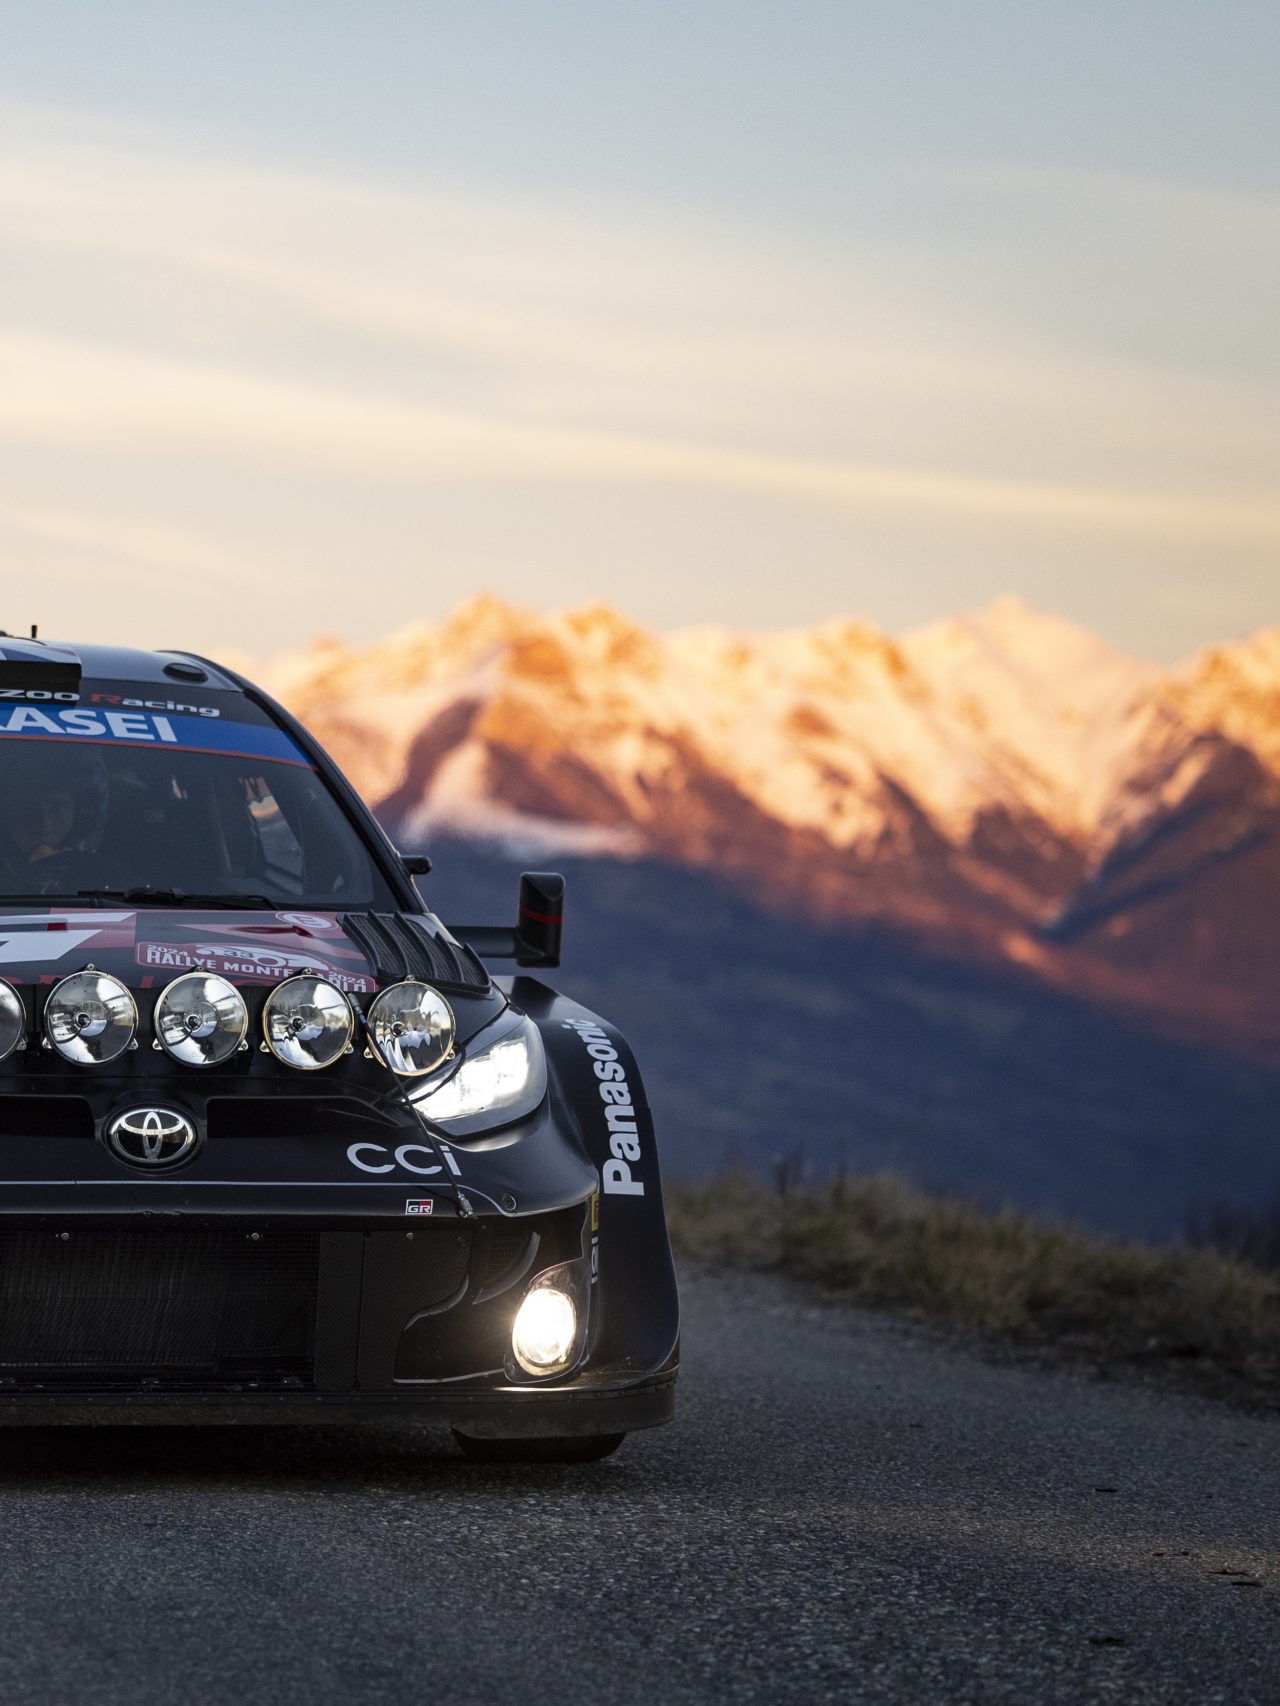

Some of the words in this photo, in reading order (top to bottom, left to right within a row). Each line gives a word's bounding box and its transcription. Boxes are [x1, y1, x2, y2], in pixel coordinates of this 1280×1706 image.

[91, 693, 220, 718] Racing
[147, 950, 216, 969] RALLYE
[148, 944, 188, 957] 2024
[560, 1018, 645, 1196] Panasonic
